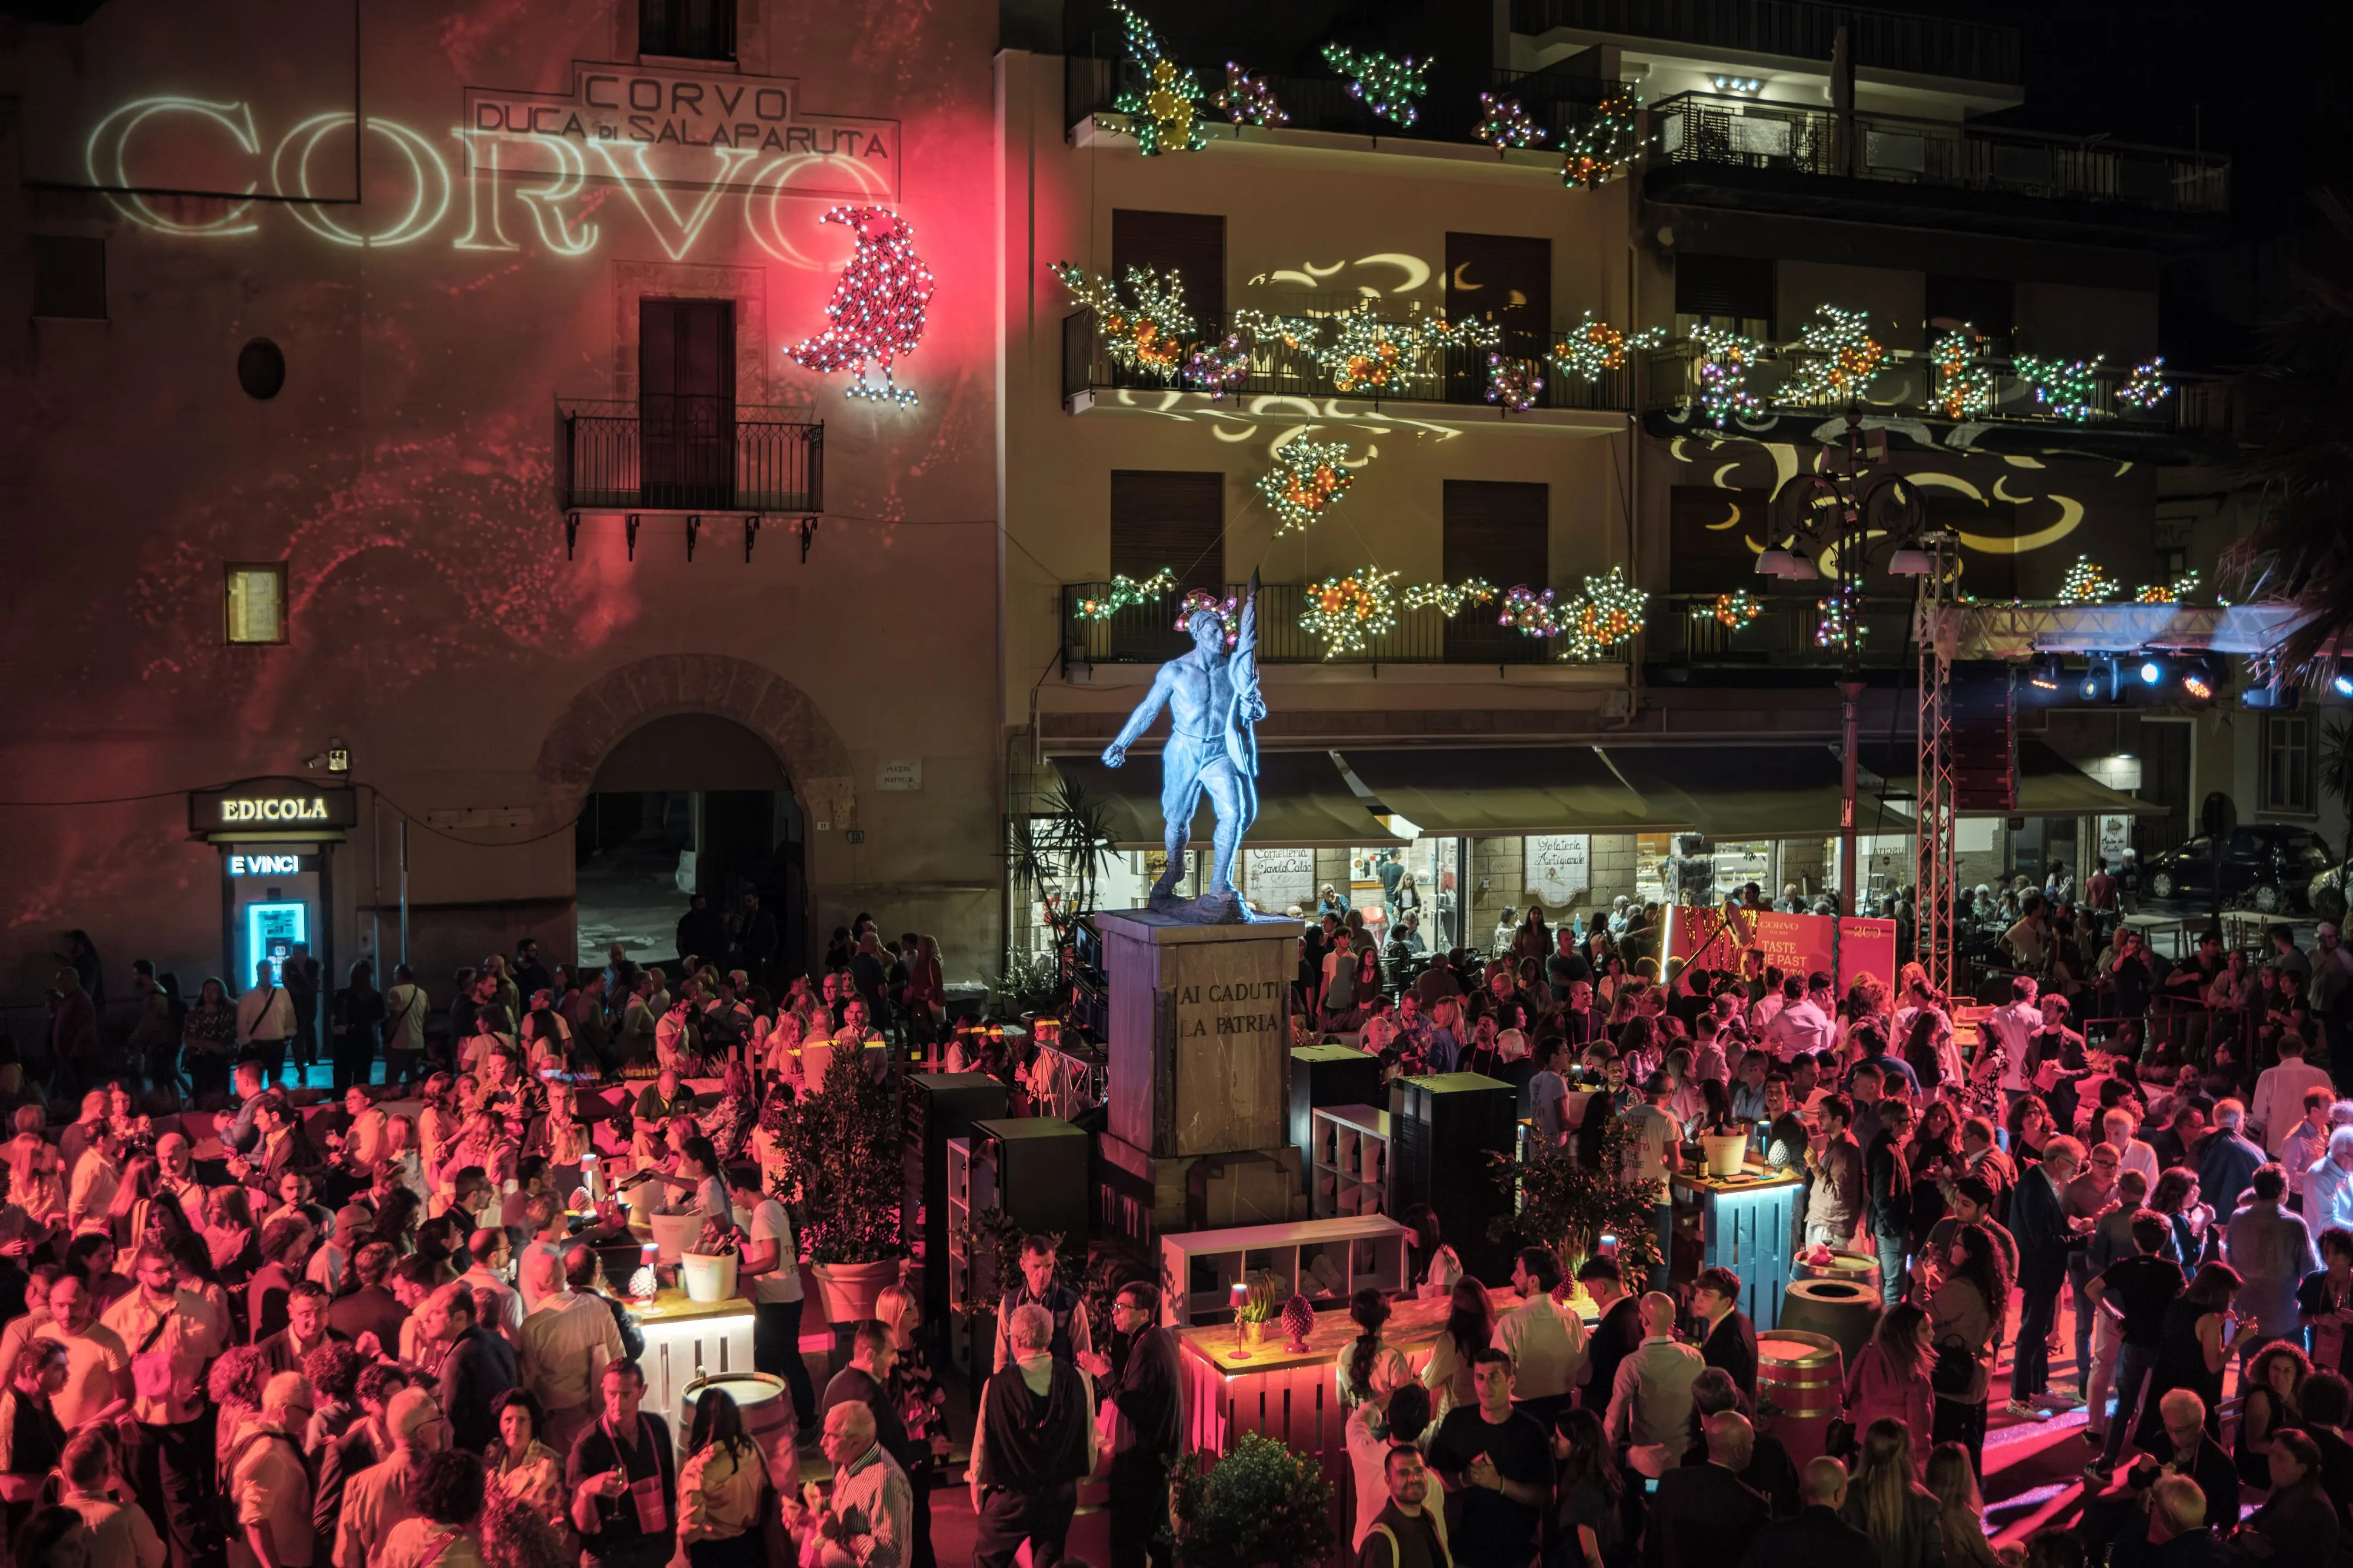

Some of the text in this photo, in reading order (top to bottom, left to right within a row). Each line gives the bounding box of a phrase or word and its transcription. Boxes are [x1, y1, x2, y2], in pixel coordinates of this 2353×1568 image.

[585, 75, 788, 122] CORVO
[476, 103, 586, 138] DUCA
[629, 114, 889, 159] SALAPARUTA
[86, 96, 900, 272] CORVO
[222, 799, 328, 821] EDICOLA
[1538, 836, 1581, 851] Gelateria
[229, 855, 299, 874] E VINCI
[1534, 850, 1585, 870] Artigianale
[1760, 920, 1799, 930] CORVO
[1762, 940, 1797, 953] TASTE
[1777, 955, 1807, 968] PAST
[1179, 982, 1280, 1005] AI CADUTI
[1180, 1013, 1278, 1039] LA PATRIA
